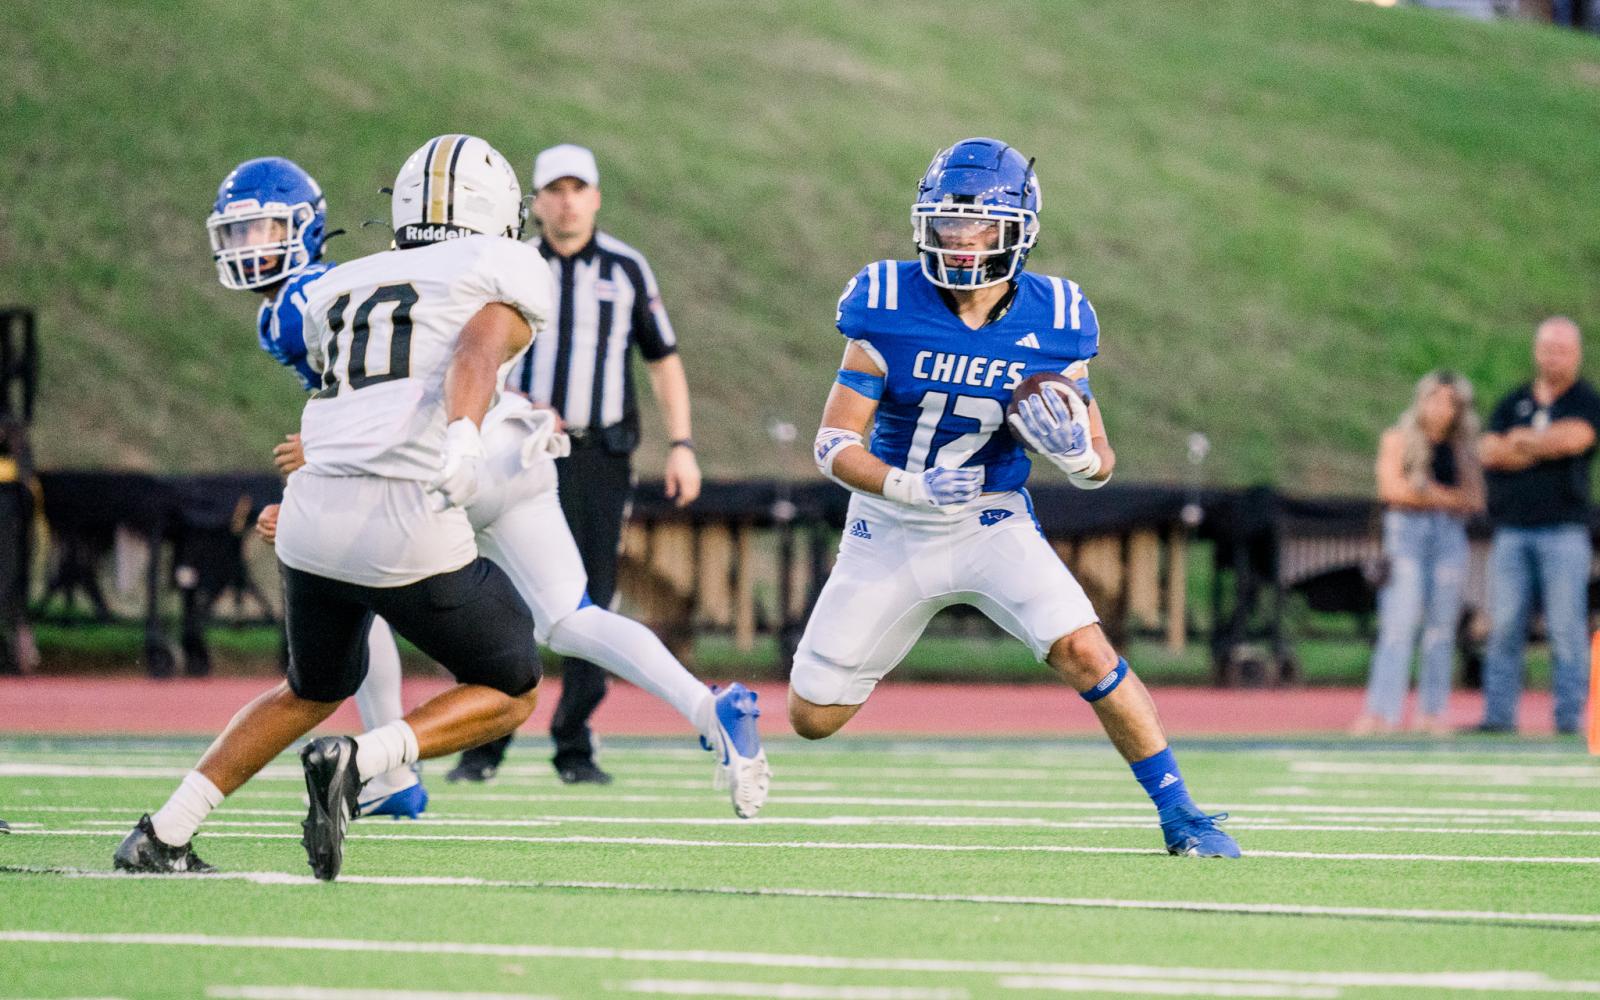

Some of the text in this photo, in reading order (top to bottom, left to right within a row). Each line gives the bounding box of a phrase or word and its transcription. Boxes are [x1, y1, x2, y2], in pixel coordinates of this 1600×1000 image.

[406, 225, 472, 240] Riddell
[312, 281, 420, 400] 10
[912, 350, 1026, 390] CHIEFS
[905, 391, 1004, 486] 12
